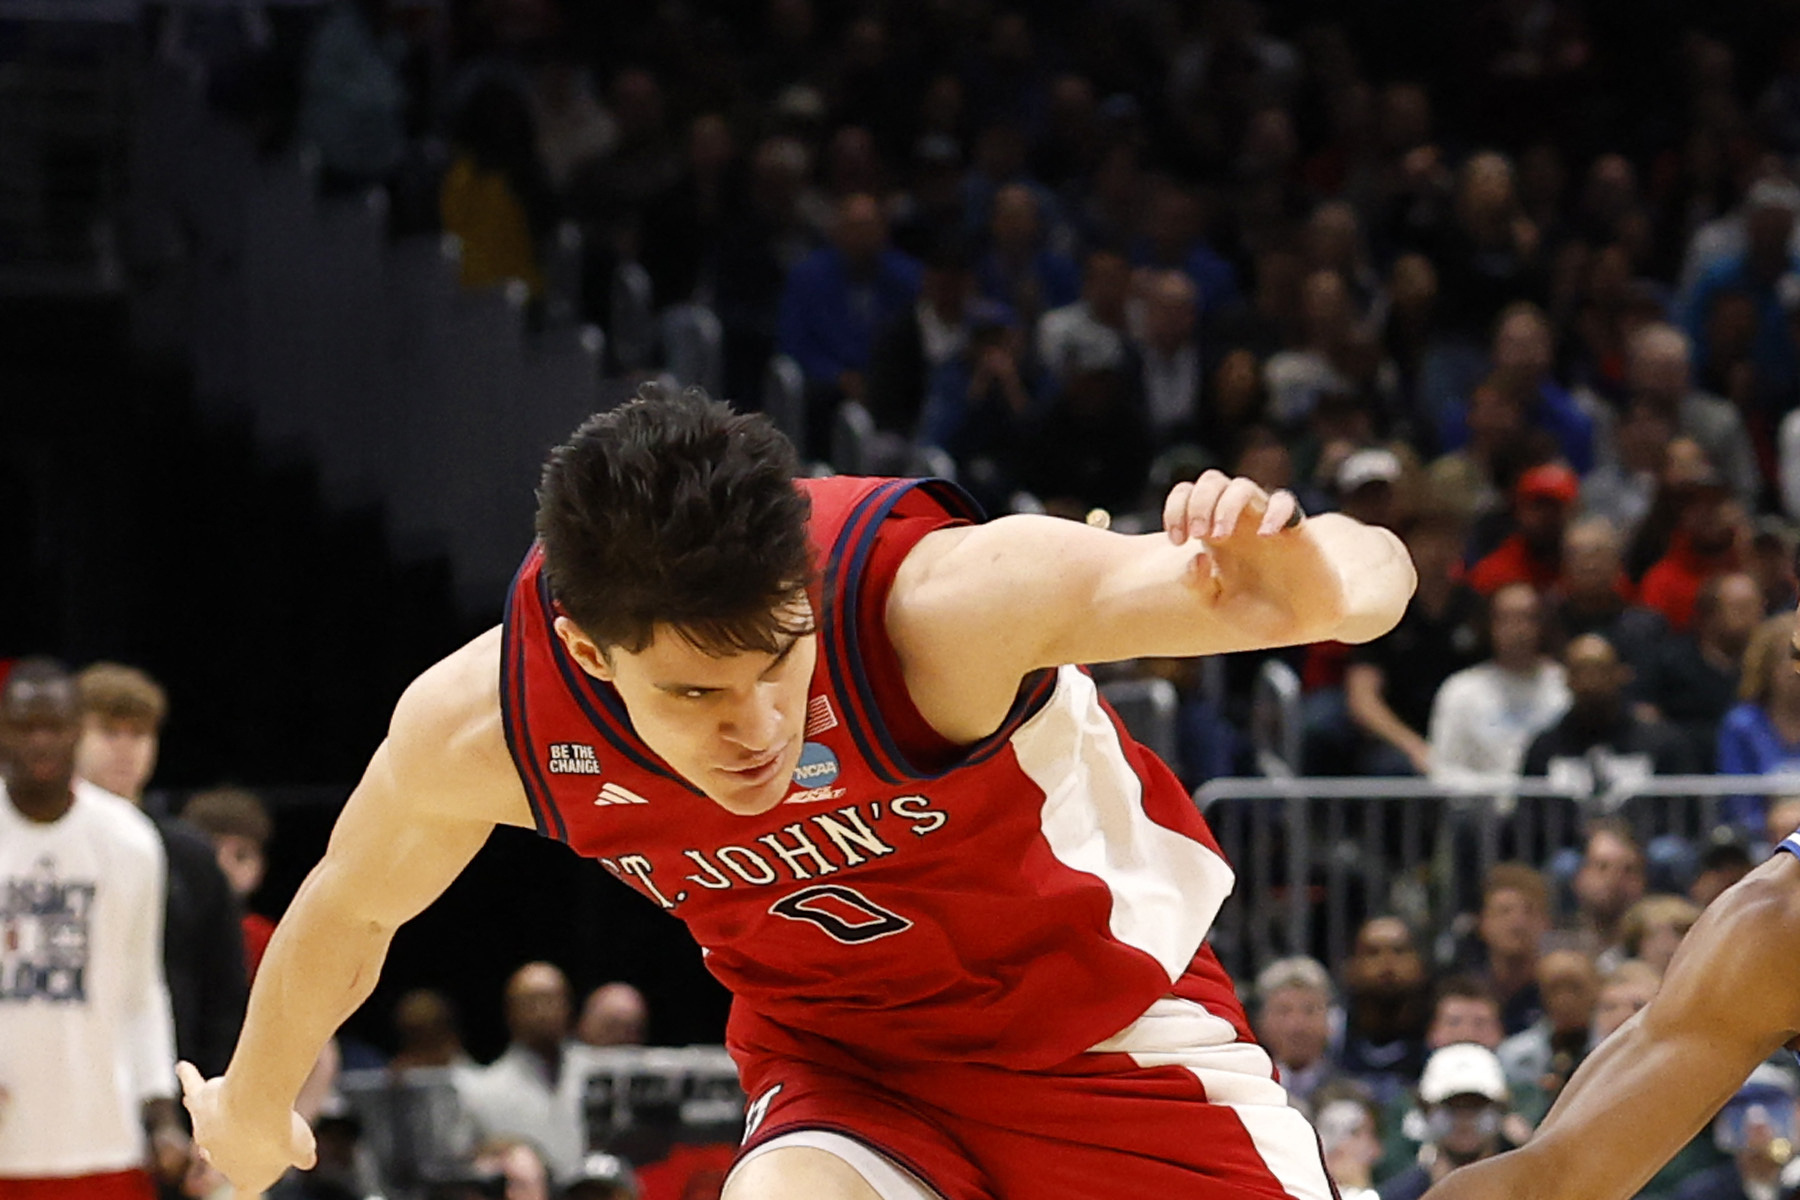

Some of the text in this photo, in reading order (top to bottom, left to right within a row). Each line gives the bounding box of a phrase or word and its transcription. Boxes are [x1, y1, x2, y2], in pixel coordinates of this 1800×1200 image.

[549, 744, 596, 760] BE THE
[549, 759, 601, 775] CHANGE
[793, 761, 838, 780] NCAA
[683, 794, 949, 890] JOHN'S
[767, 884, 914, 944] 0
